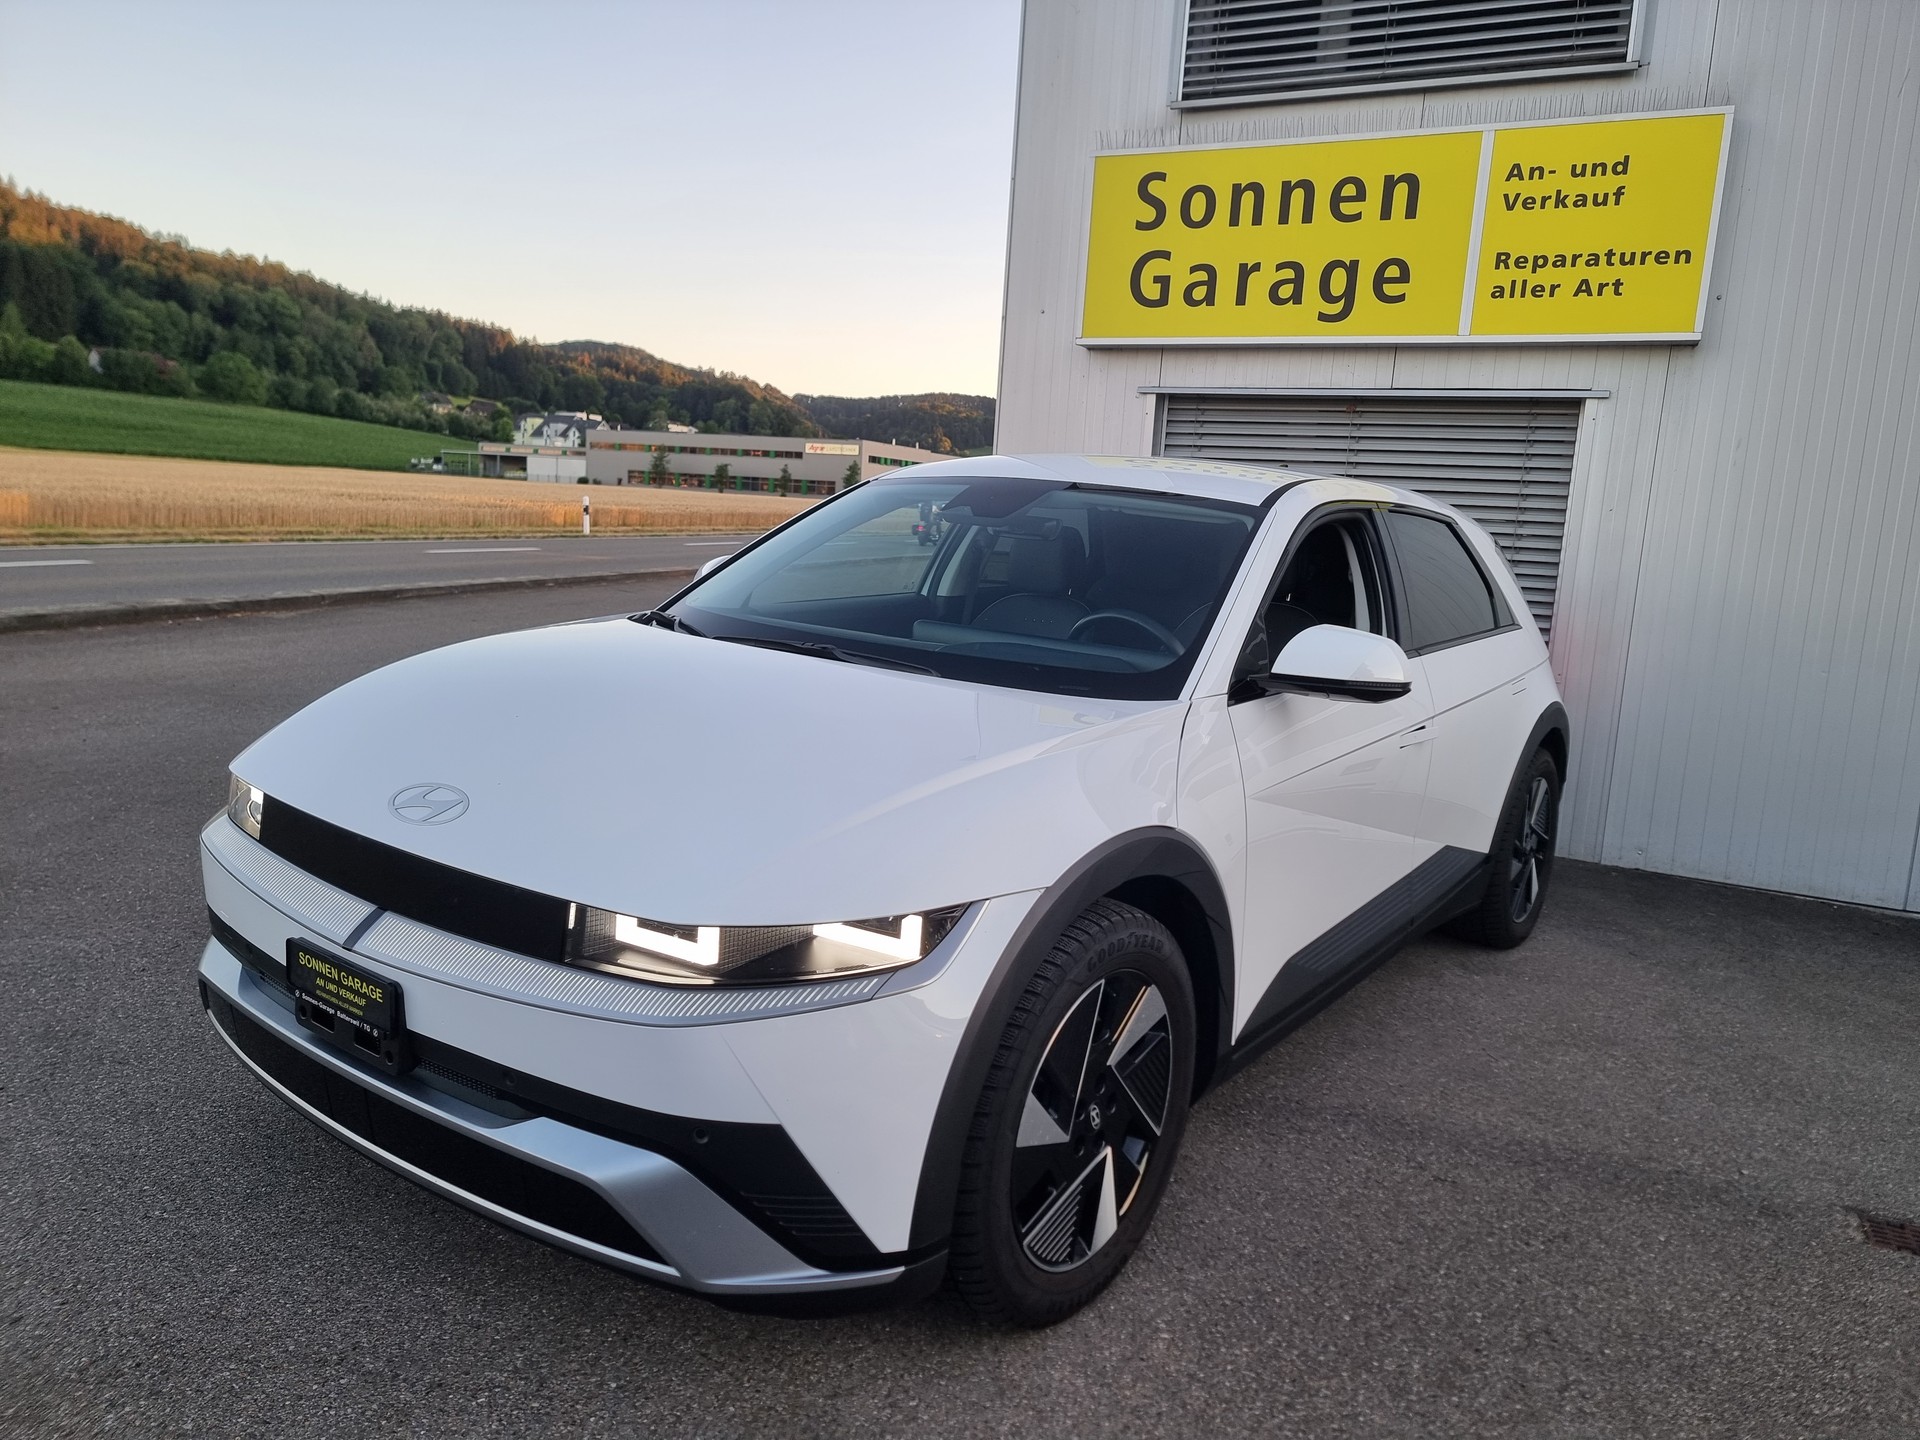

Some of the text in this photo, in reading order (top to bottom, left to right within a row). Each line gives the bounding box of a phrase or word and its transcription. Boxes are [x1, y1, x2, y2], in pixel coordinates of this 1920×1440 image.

[1504, 155, 1630, 182] An- und
[1135, 171, 1420, 232] Sonnen
[1502, 186, 1626, 212] Verkauf
[1494, 248, 1692, 274] Reparaturen
[1129, 249, 1411, 324] Garage
[1490, 277, 1624, 300] aller Art
[1087, 931, 1164, 973] GOODYEAR
[298, 951, 383, 1003] SONNEN GARAGE
[301, 992, 335, 1015] Sonnen-Garage
[315, 977, 367, 1007] AN UND VERKAUF
